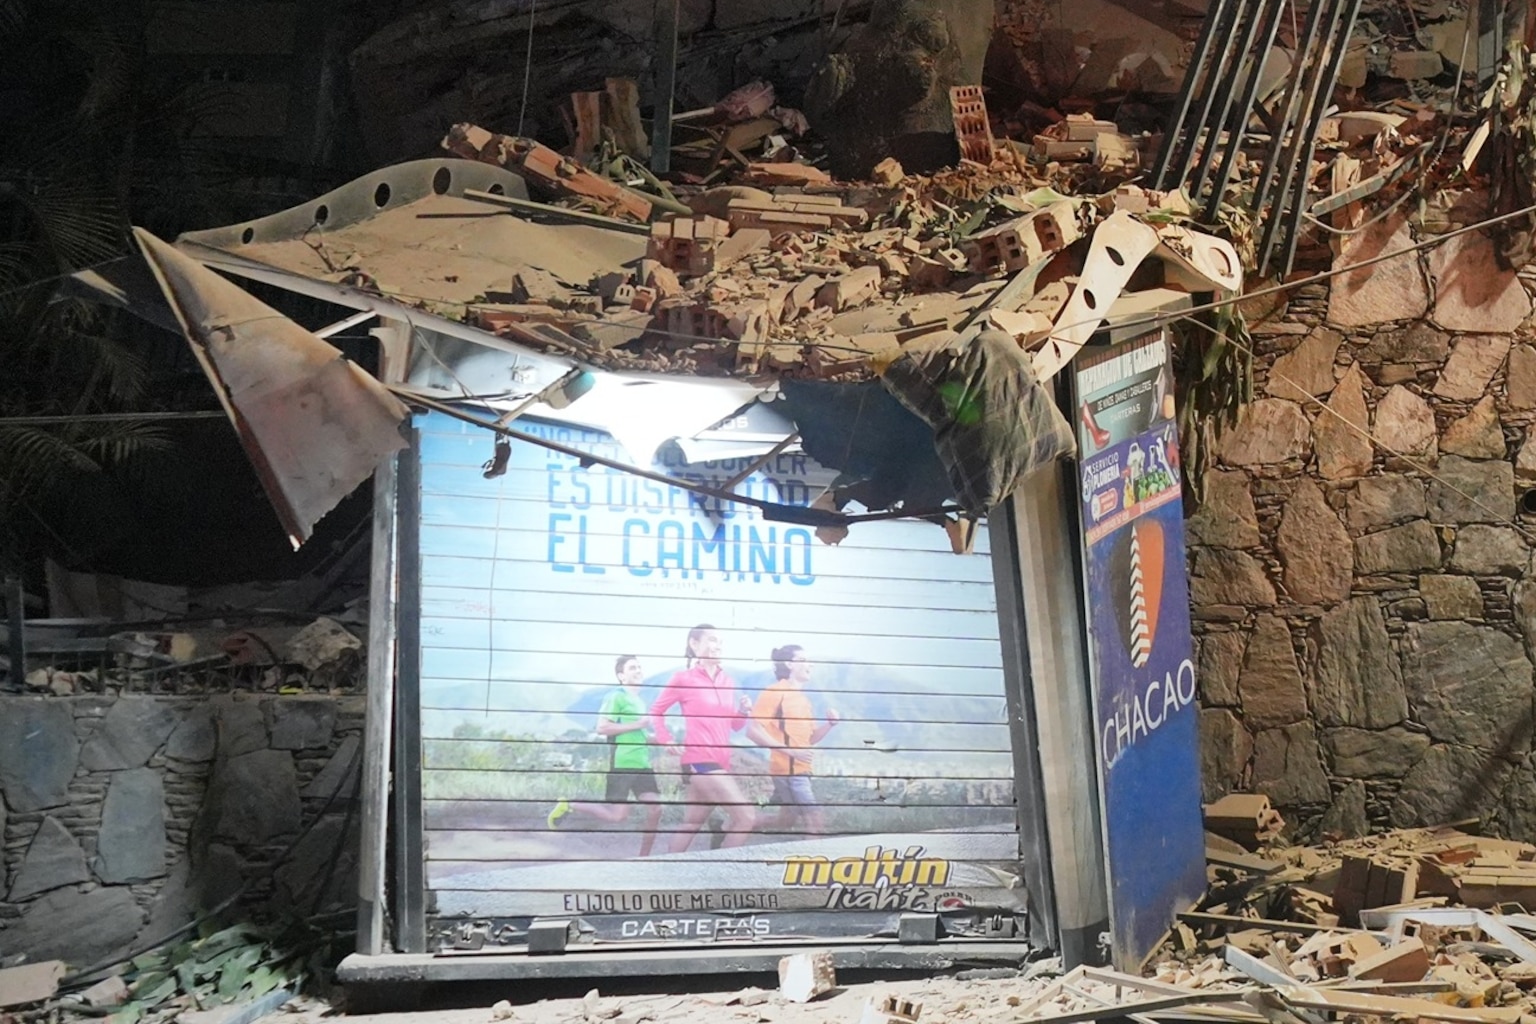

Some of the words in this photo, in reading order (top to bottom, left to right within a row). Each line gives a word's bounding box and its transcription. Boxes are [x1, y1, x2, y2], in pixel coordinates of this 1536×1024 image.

[1091, 451, 1119, 474] SERVICIO
[546, 463, 592, 510] ES
[548, 513, 606, 574] EL
[622, 518, 816, 586] CAMINO
[1103, 658, 1195, 769] CHACAO
[783, 845, 951, 886] maltín
[564, 894, 615, 911] ELIJO
[622, 893, 643, 911] LO
[650, 893, 683, 911] QUE
[691, 893, 713, 909] ME
[721, 893, 779, 909] GUSTA
